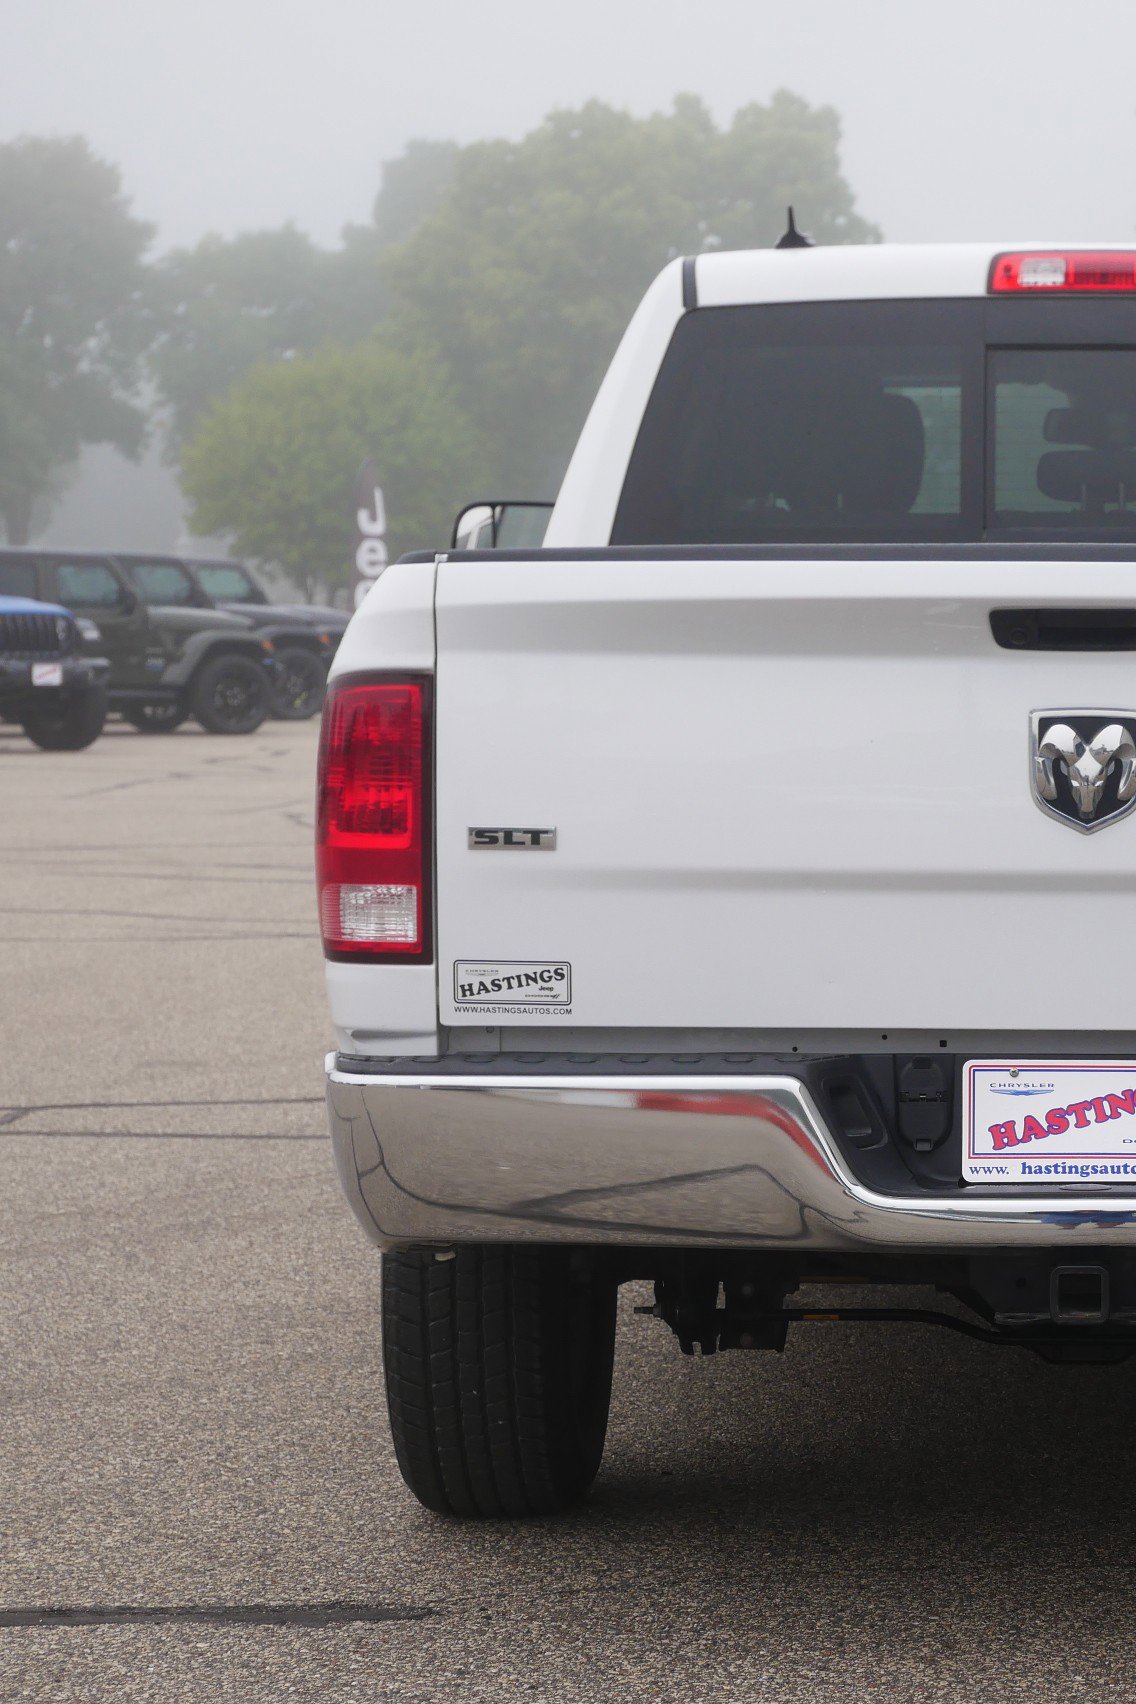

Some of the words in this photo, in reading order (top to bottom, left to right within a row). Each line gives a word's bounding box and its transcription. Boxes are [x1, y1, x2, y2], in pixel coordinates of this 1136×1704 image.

[474, 829, 549, 845] SLT
[459, 967, 565, 998] HASTINGS
[454, 1006, 572, 1015] WWW.HASTINGSAUTOS.COM
